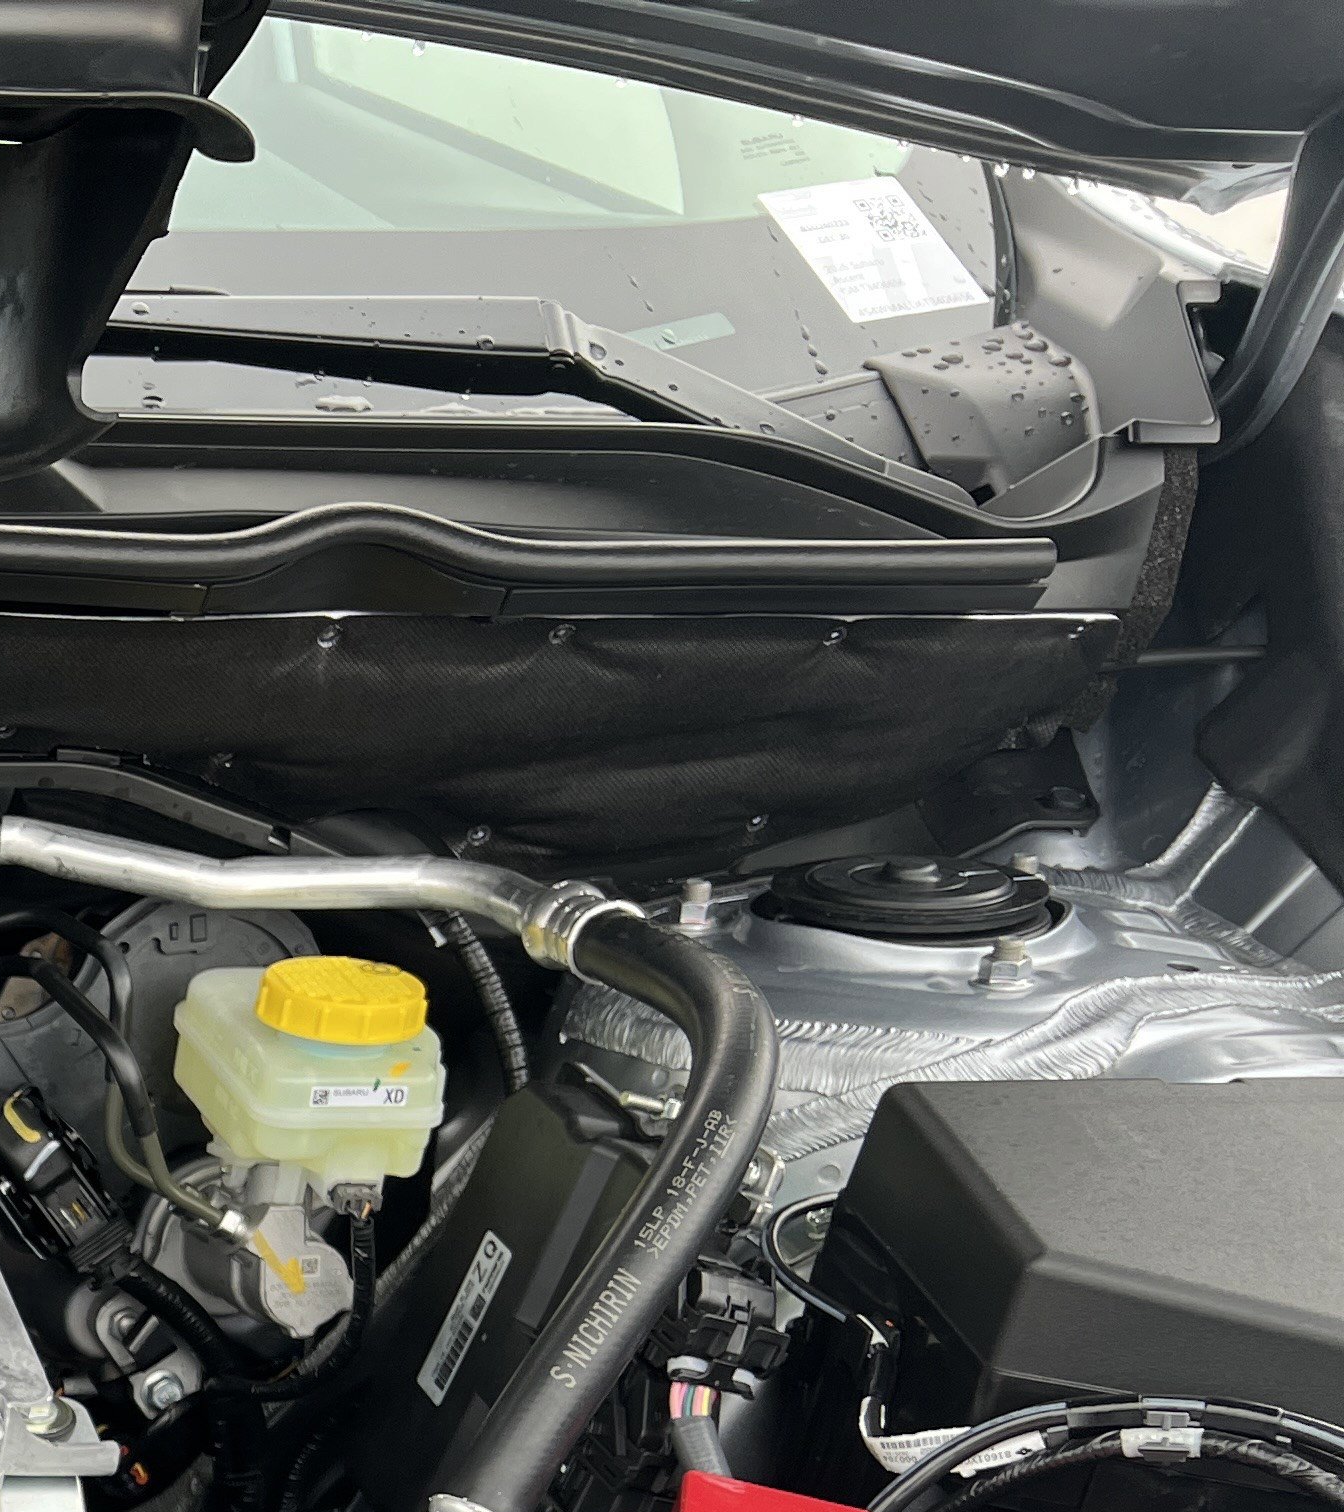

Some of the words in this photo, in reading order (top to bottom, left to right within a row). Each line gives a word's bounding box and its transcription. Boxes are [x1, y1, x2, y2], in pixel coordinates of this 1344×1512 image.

[333, 1089, 369, 1097] SUBARU
[383, 1088, 405, 1105] XD
[634, 1205, 664, 1248] 15LP
